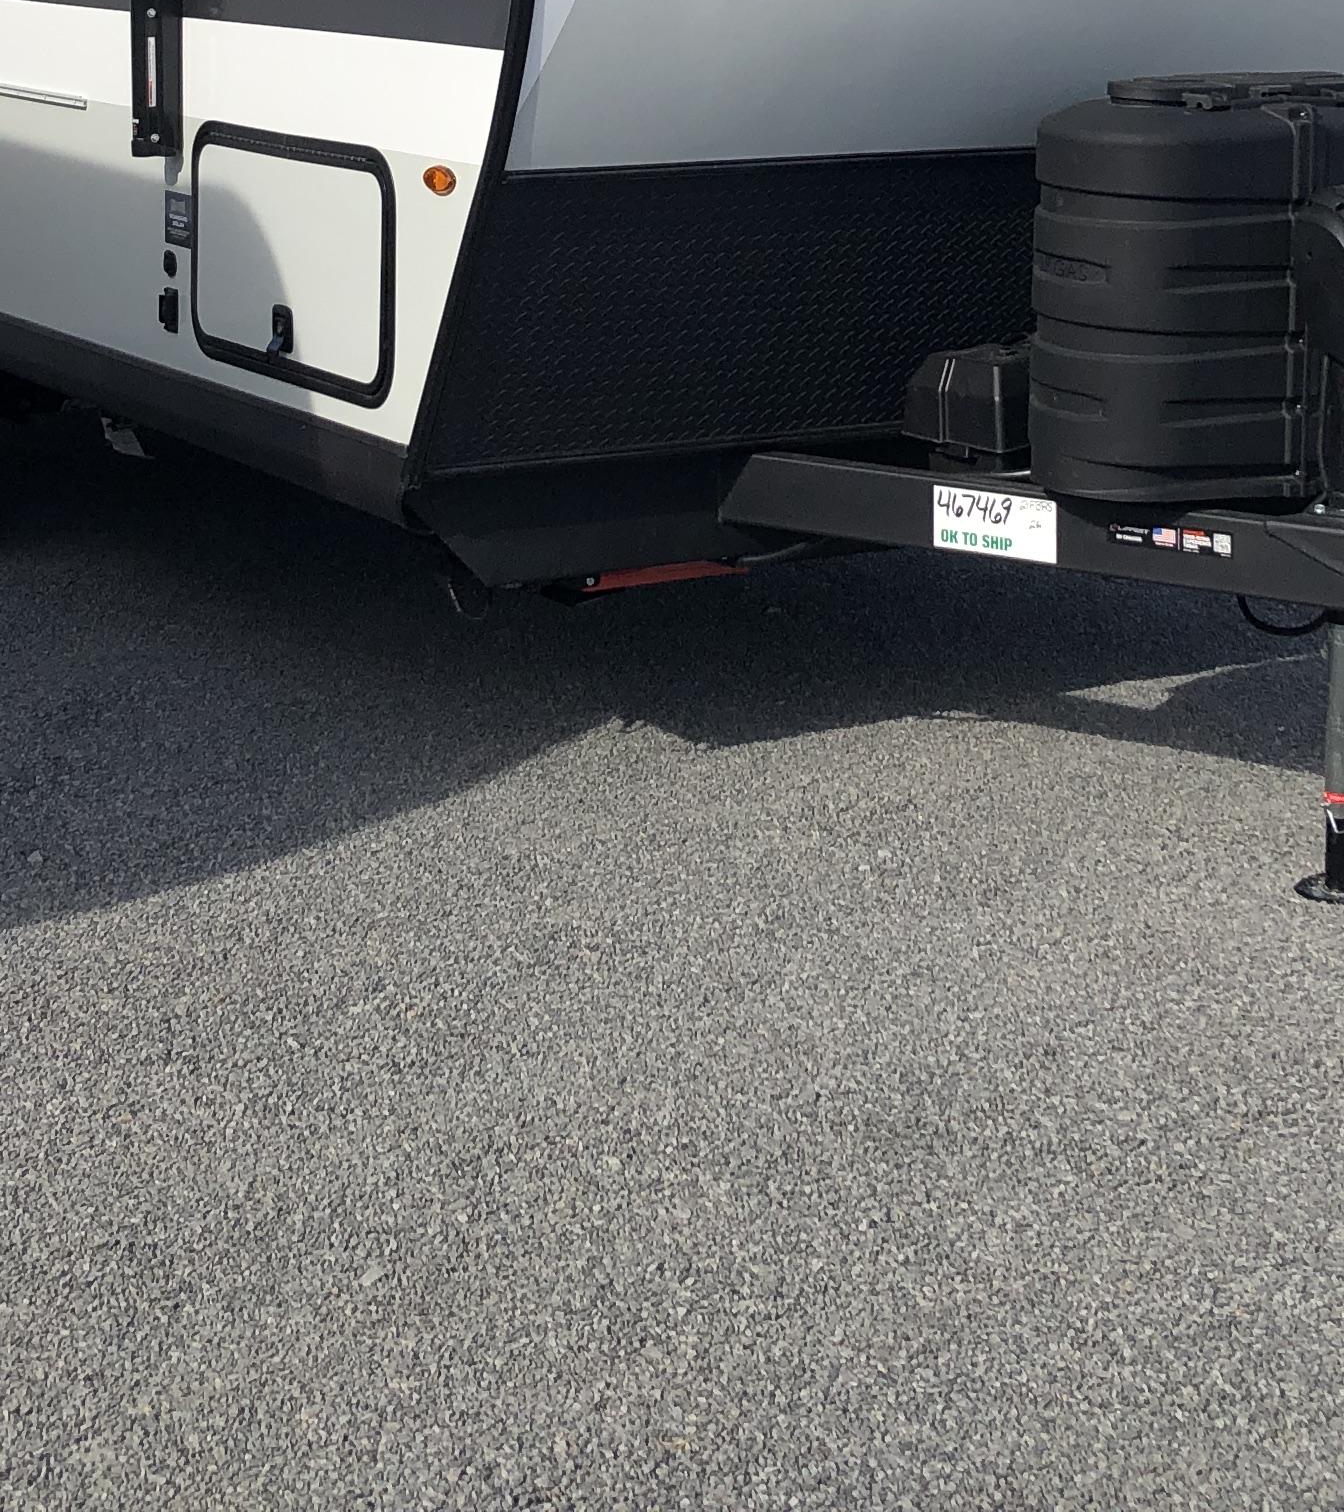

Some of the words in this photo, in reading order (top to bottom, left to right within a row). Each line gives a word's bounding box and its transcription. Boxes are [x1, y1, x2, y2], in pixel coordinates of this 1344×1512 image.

[937, 489, 1013, 525] 467469
[940, 528, 958, 544] OK
[961, 531, 978, 547] TO
[981, 534, 1013, 551] SHIP
